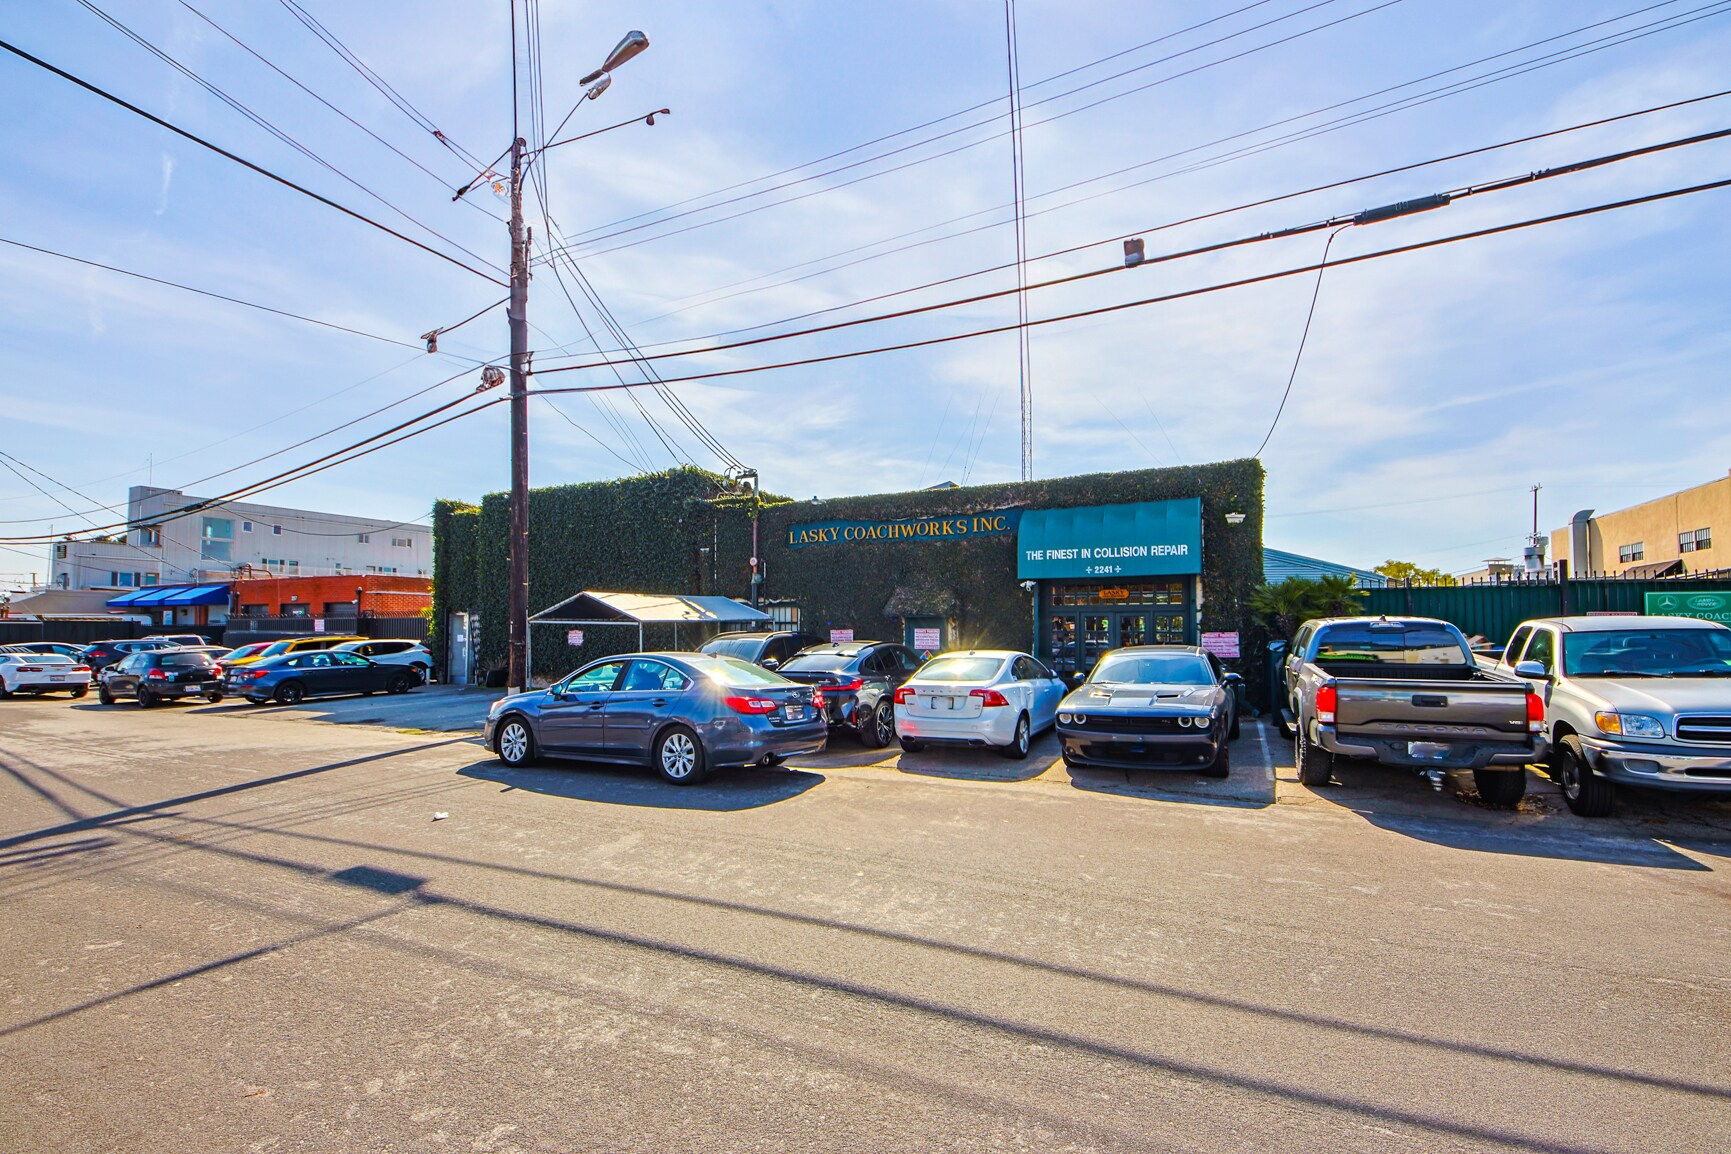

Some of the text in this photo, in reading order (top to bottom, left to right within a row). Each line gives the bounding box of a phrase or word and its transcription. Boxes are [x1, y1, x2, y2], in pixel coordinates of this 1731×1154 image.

[788, 515, 1012, 545] LASKY COACHWORKS INC.
[1026, 544, 1189, 561] THE FINEST IN COLLISION REPAIR
[1094, 565, 1113, 574] 2241
[1696, 612, 1731, 620] COAC
[1376, 722, 1488, 735] TACOMA
